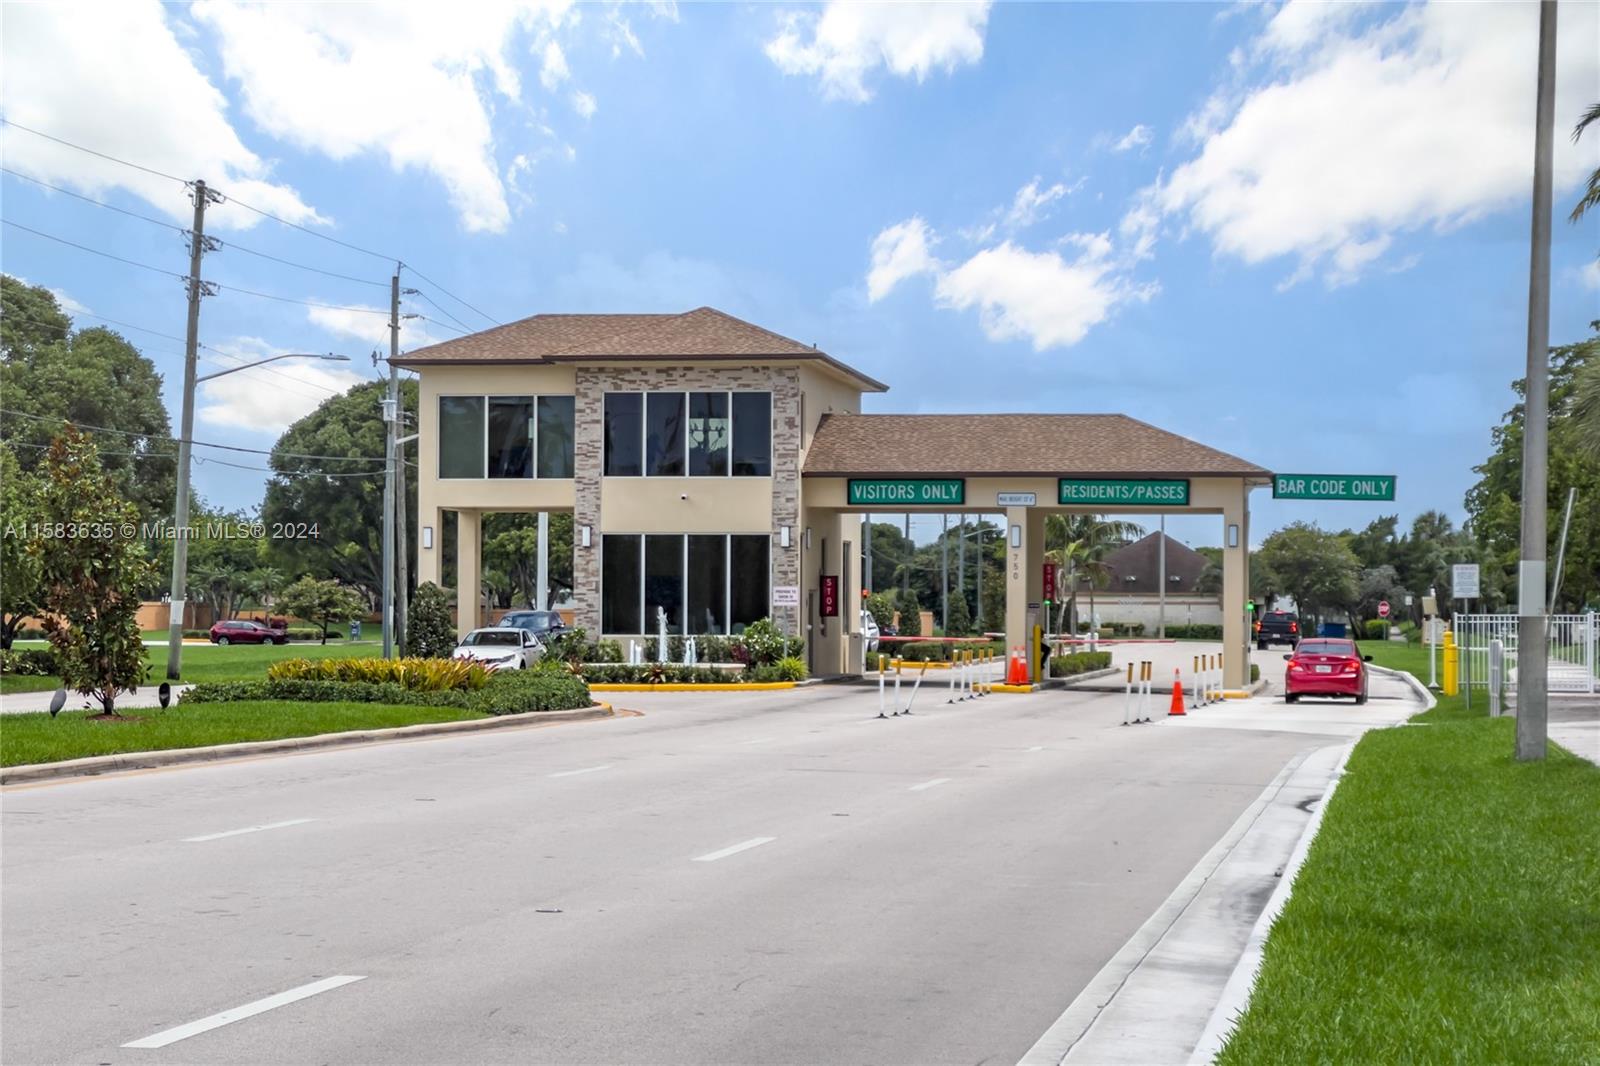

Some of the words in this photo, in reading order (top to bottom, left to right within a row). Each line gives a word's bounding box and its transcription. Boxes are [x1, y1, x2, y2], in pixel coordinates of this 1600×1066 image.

[854, 484, 915, 500] VISITORS
[922, 484, 959, 500] ONLY
[1063, 485, 1185, 500] RESIDENTS/PASSES
[1279, 480, 1305, 494] BAR
[1310, 480, 1347, 495] CODE
[1352, 481, 1389, 496] ONLY
[825, 578, 833, 614] STOP
